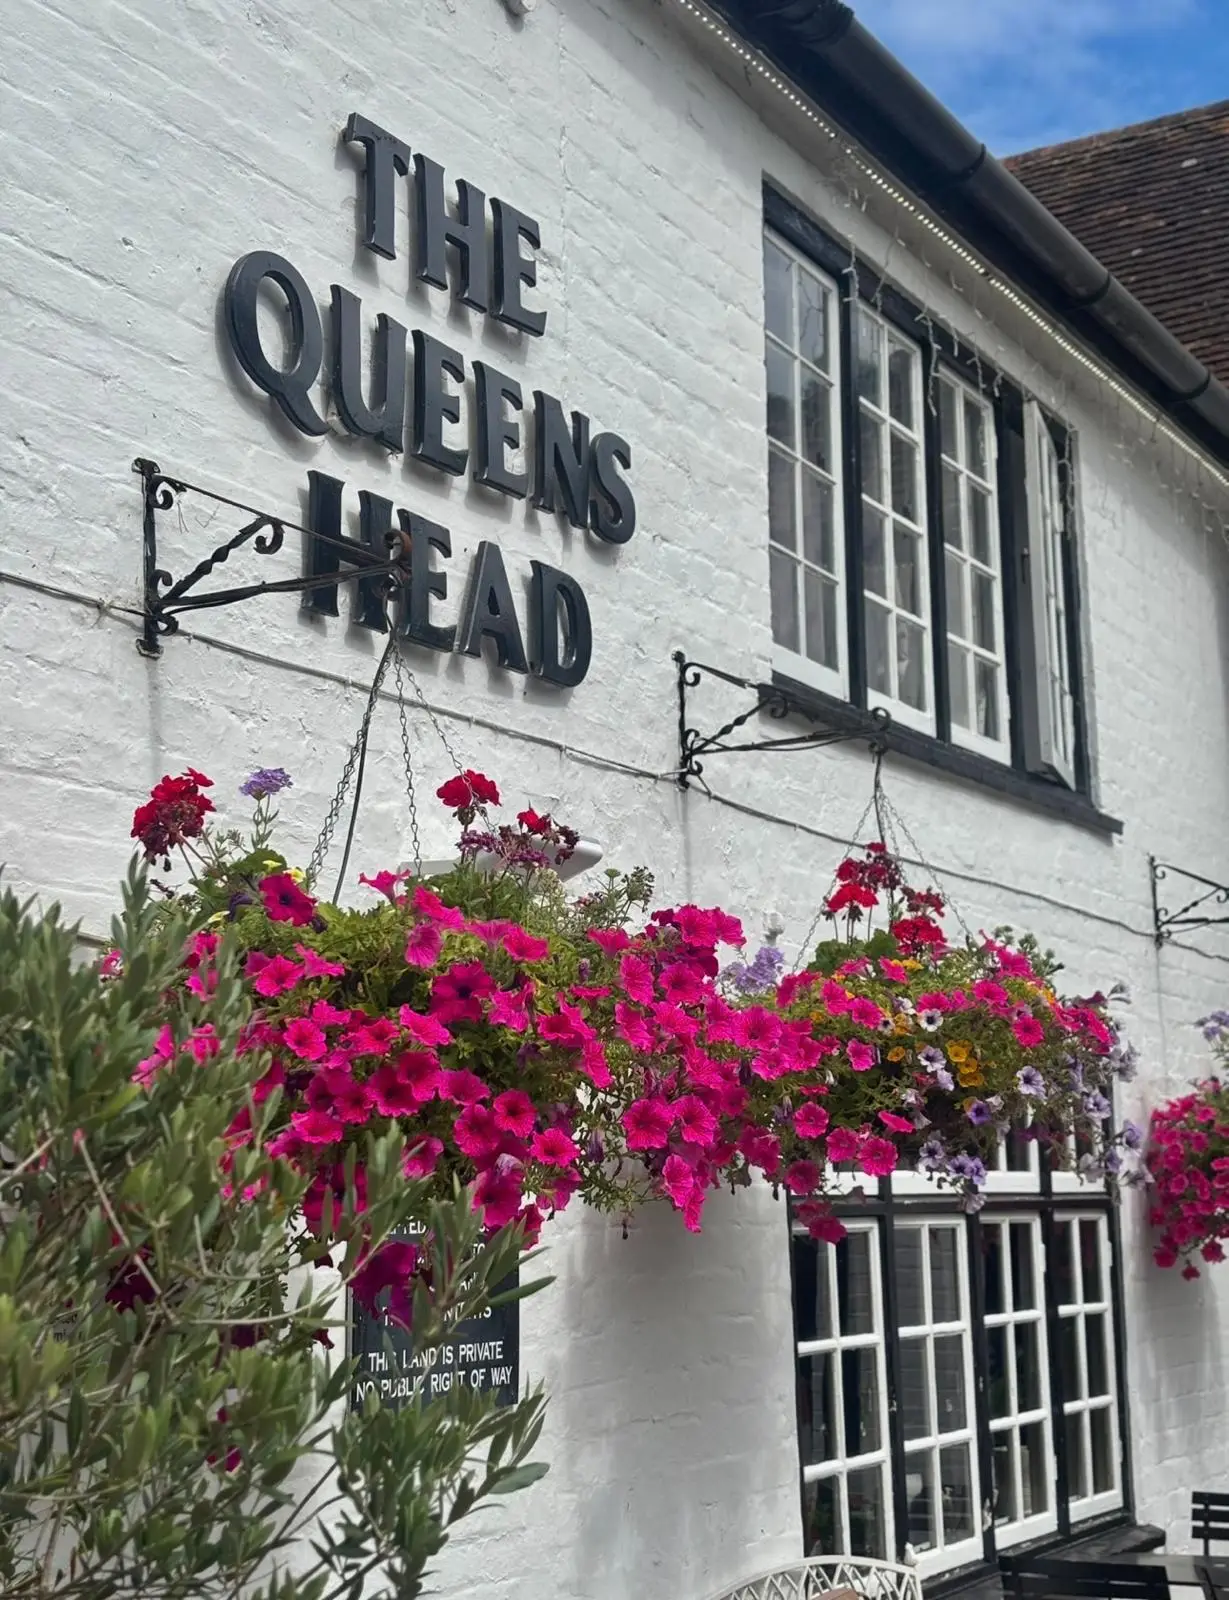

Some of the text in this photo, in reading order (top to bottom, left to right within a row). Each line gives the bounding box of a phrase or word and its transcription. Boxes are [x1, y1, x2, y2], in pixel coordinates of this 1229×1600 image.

[344, 112, 548, 337] THE
[224, 250, 637, 545] QUEENS
[302, 469, 592, 688] HEAD
[368, 1340, 504, 1373] THI LAND IS PRIVATE
[380, 1374, 425, 1400] PUBLIC
[470, 1368, 487, 1388] OF
[490, 1366, 514, 1386] WAY
